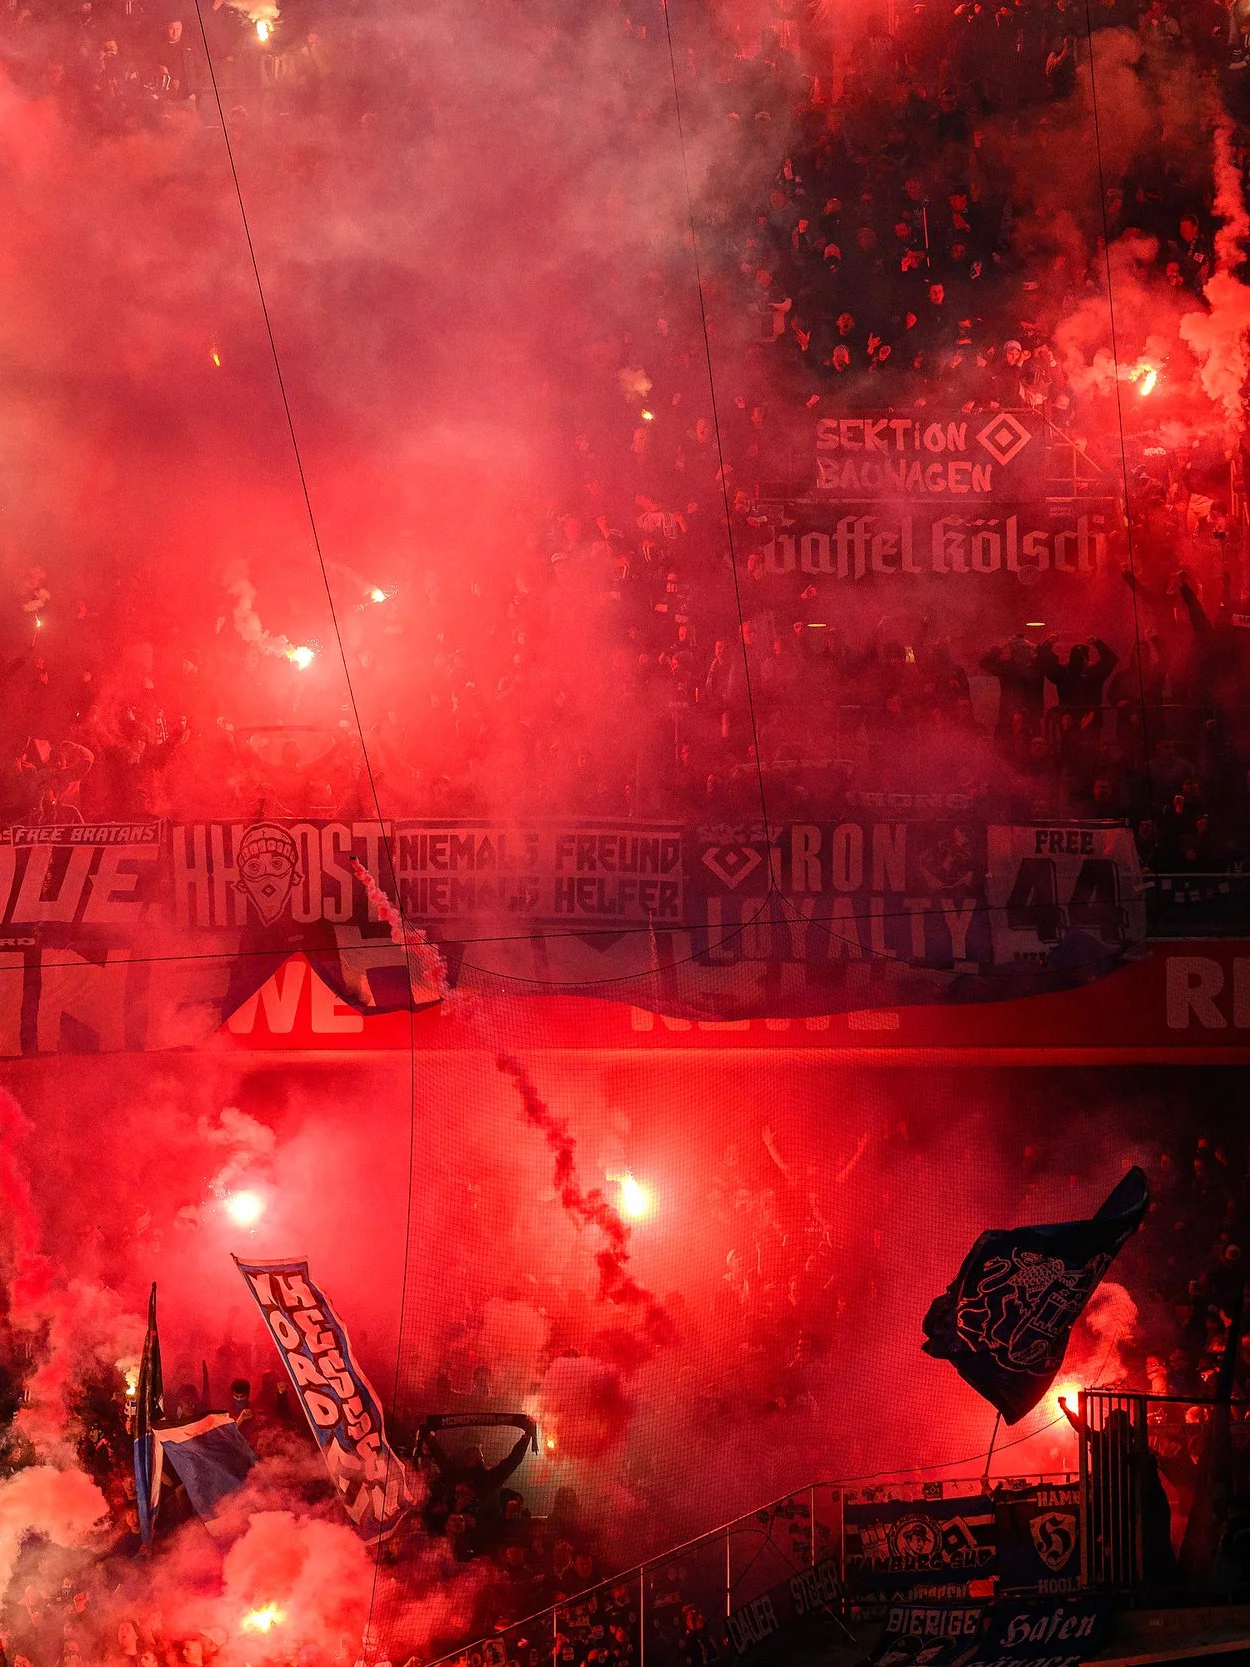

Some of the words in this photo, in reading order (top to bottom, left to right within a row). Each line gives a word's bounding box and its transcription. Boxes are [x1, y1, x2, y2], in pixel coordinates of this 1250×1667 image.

[14, 826, 63, 842] FREE
[70, 826, 155, 842] BRATANS
[1035, 830, 1094, 855] FREE
[555, 835, 680, 874] FREUND
[555, 878, 678, 918] HELFER
[1007, 858, 1120, 946] 44
[707, 897, 979, 960] LOYALTY
[886, 1607, 982, 1635] BIERIGE
[999, 1607, 1097, 1648] Hafen
